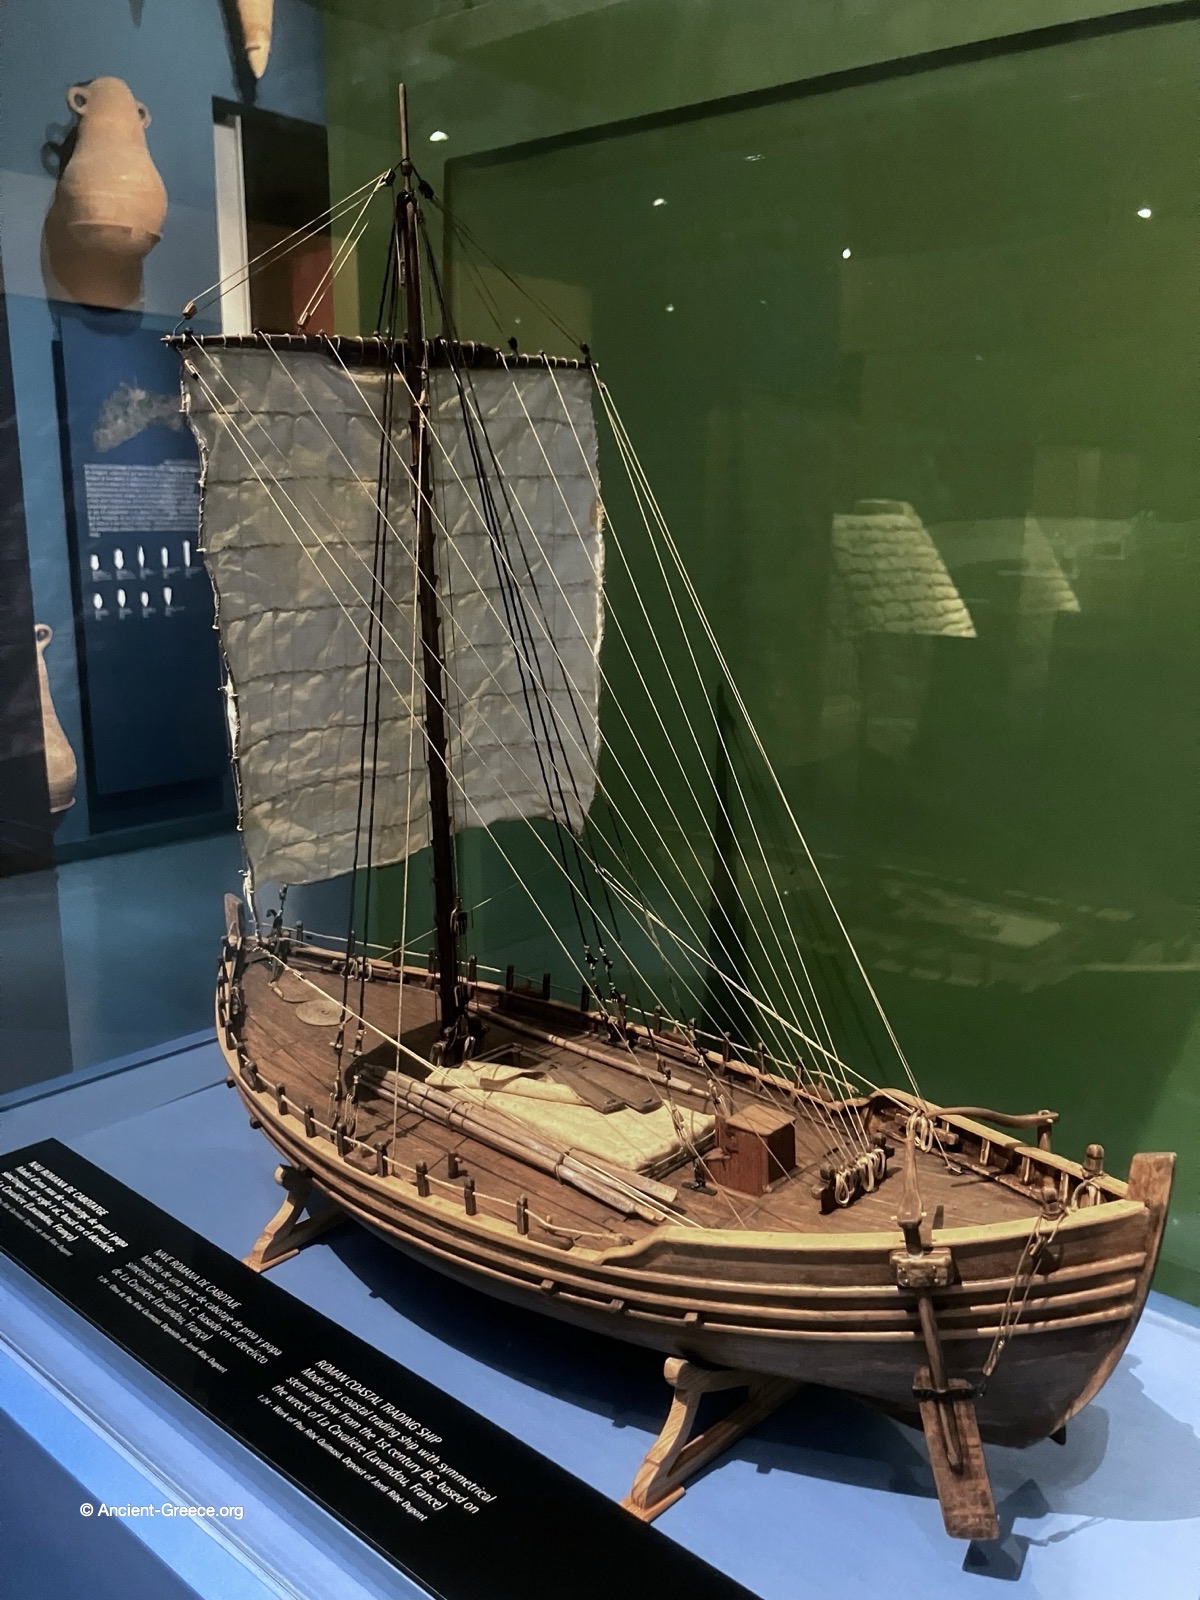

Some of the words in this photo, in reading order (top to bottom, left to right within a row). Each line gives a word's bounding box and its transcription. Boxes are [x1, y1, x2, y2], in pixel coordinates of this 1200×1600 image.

[196, 1279, 210, 1287] DE
[206, 1286, 242, 1309] CABOTAJE
[196, 1296, 207, 1304] de
[204, 1302, 234, 1322] cabotaje
[238, 1327, 259, 1339] proa
[259, 1342, 282, 1356] popa
[197, 1312, 222, 1331] basado
[220, 1330, 232, 1338] en
[236, 1341, 268, 1364] derelicto
[272, 1385, 288, 1396] the
[285, 1395, 311, 1413] wreck
[307, 1411, 324, 1419] of
[317, 1417, 330, 1427] La
[362, 1450, 410, 1487] (Lavandou,
[409, 1483, 448, 1510] France)
[301, 1368, 330, 1386] Model
[340, 1396, 374, 1416] coastal
[368, 1415, 401, 1438] trading
[397, 1436, 419, 1450] ship
[417, 1449, 440, 1464] with
[437, 1463, 497, 1503] symmetrical
[315, 1360, 350, 1382] ROMAN
[345, 1380, 383, 1406] COASTAL
[380, 1402, 421, 1430] TRADING
[416, 1428, 442, 1443] SHIP
[272, 1405, 289, 1418] Work
[342, 1457, 367, 1475] Deposit
[371, 1479, 389, 1492] Jordi
[401, 1501, 428, 1521] Dupont
[305, 1391, 326, 1403] and
[321, 1400, 341, 1415] bow
[339, 1413, 361, 1429] from
[359, 1427, 376, 1440] the
[375, 1438, 391, 1450] 1st
[388, 1448, 423, 1473] century
[420, 1470, 440, 1485] BC,
[436, 1481, 469, 1503] based
[463, 1502, 479, 1514] on
